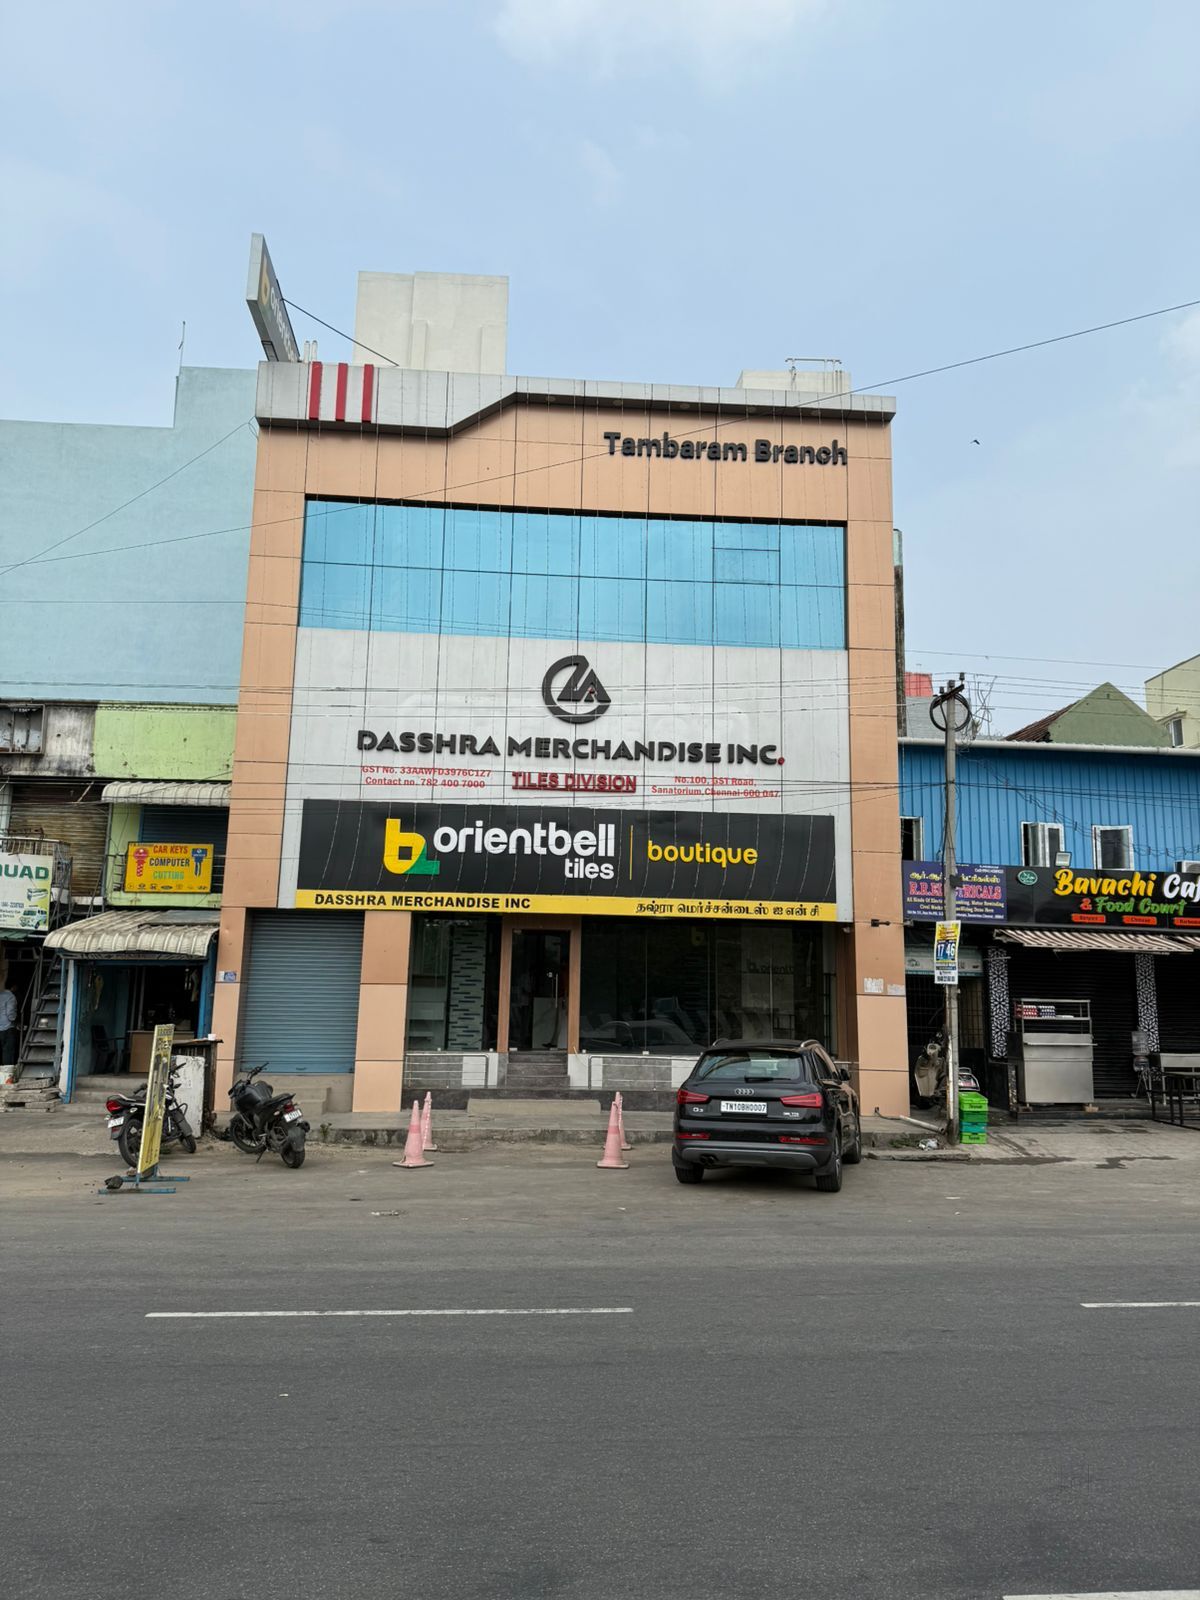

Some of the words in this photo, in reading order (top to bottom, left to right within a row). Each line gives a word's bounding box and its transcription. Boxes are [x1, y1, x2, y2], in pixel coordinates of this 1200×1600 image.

[604, 432, 747, 462] Tambaram
[755, 439, 847, 465] Branch
[357, 730, 501, 757] DASSHRA
[507, 736, 722, 764] MERCHANDISE
[727, 743, 785, 766] INC.
[365, 777, 402, 785] Contact
[420, 778, 438, 786] 782
[442, 779, 460, 787] 400
[462, 780, 486, 788] 7000
[512, 771, 559, 789] TILES
[564, 773, 636, 791] DIVISION
[712, 777, 728, 786] GST
[153, 845, 168, 854] CAR
[170, 846, 188, 854] KEYS
[433, 820, 615, 857] orientbell
[647, 840, 758, 868] boutique
[0, 864, 49, 880] UAD
[149, 857, 190, 867] COMPUTER
[564, 857, 615, 880] tiles
[1053, 869, 1157, 897] Bavachi
[315, 893, 387, 906] DASSHRA
[391, 895, 500, 908] MERCHANDISE
[505, 898, 531, 909] INC
[1080, 897, 1092, 910] &
[1095, 896, 1135, 913] Food
[1139, 897, 1187, 916] Court
